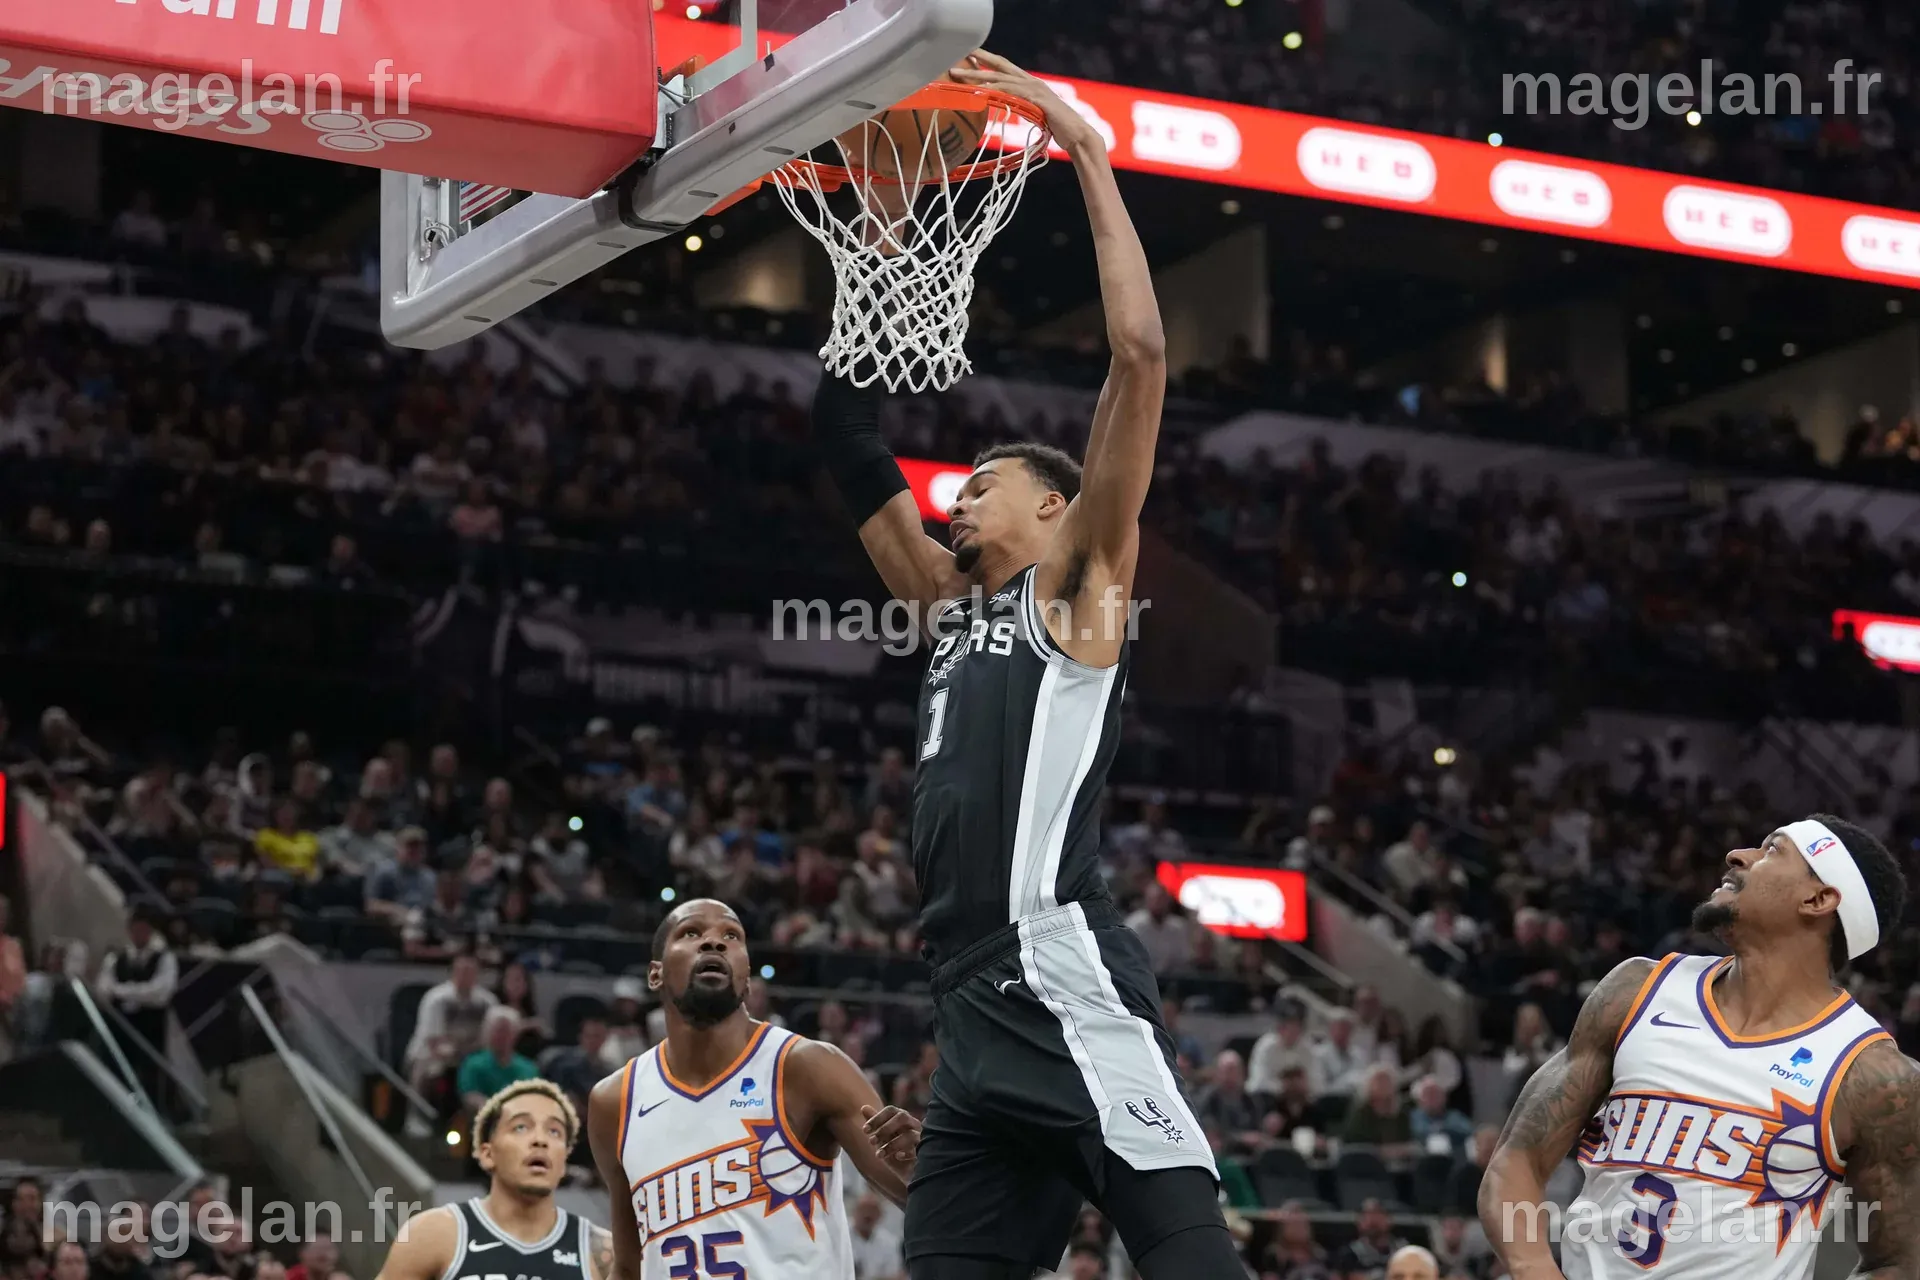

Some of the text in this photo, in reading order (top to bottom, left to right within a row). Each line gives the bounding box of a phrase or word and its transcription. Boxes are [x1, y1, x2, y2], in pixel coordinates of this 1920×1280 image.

[920, 687, 950, 762] 1
[1769, 1063, 1815, 1088] PayPal
[730, 1098, 764, 1108] PayPal
[1617, 1172, 1678, 1269] 3
